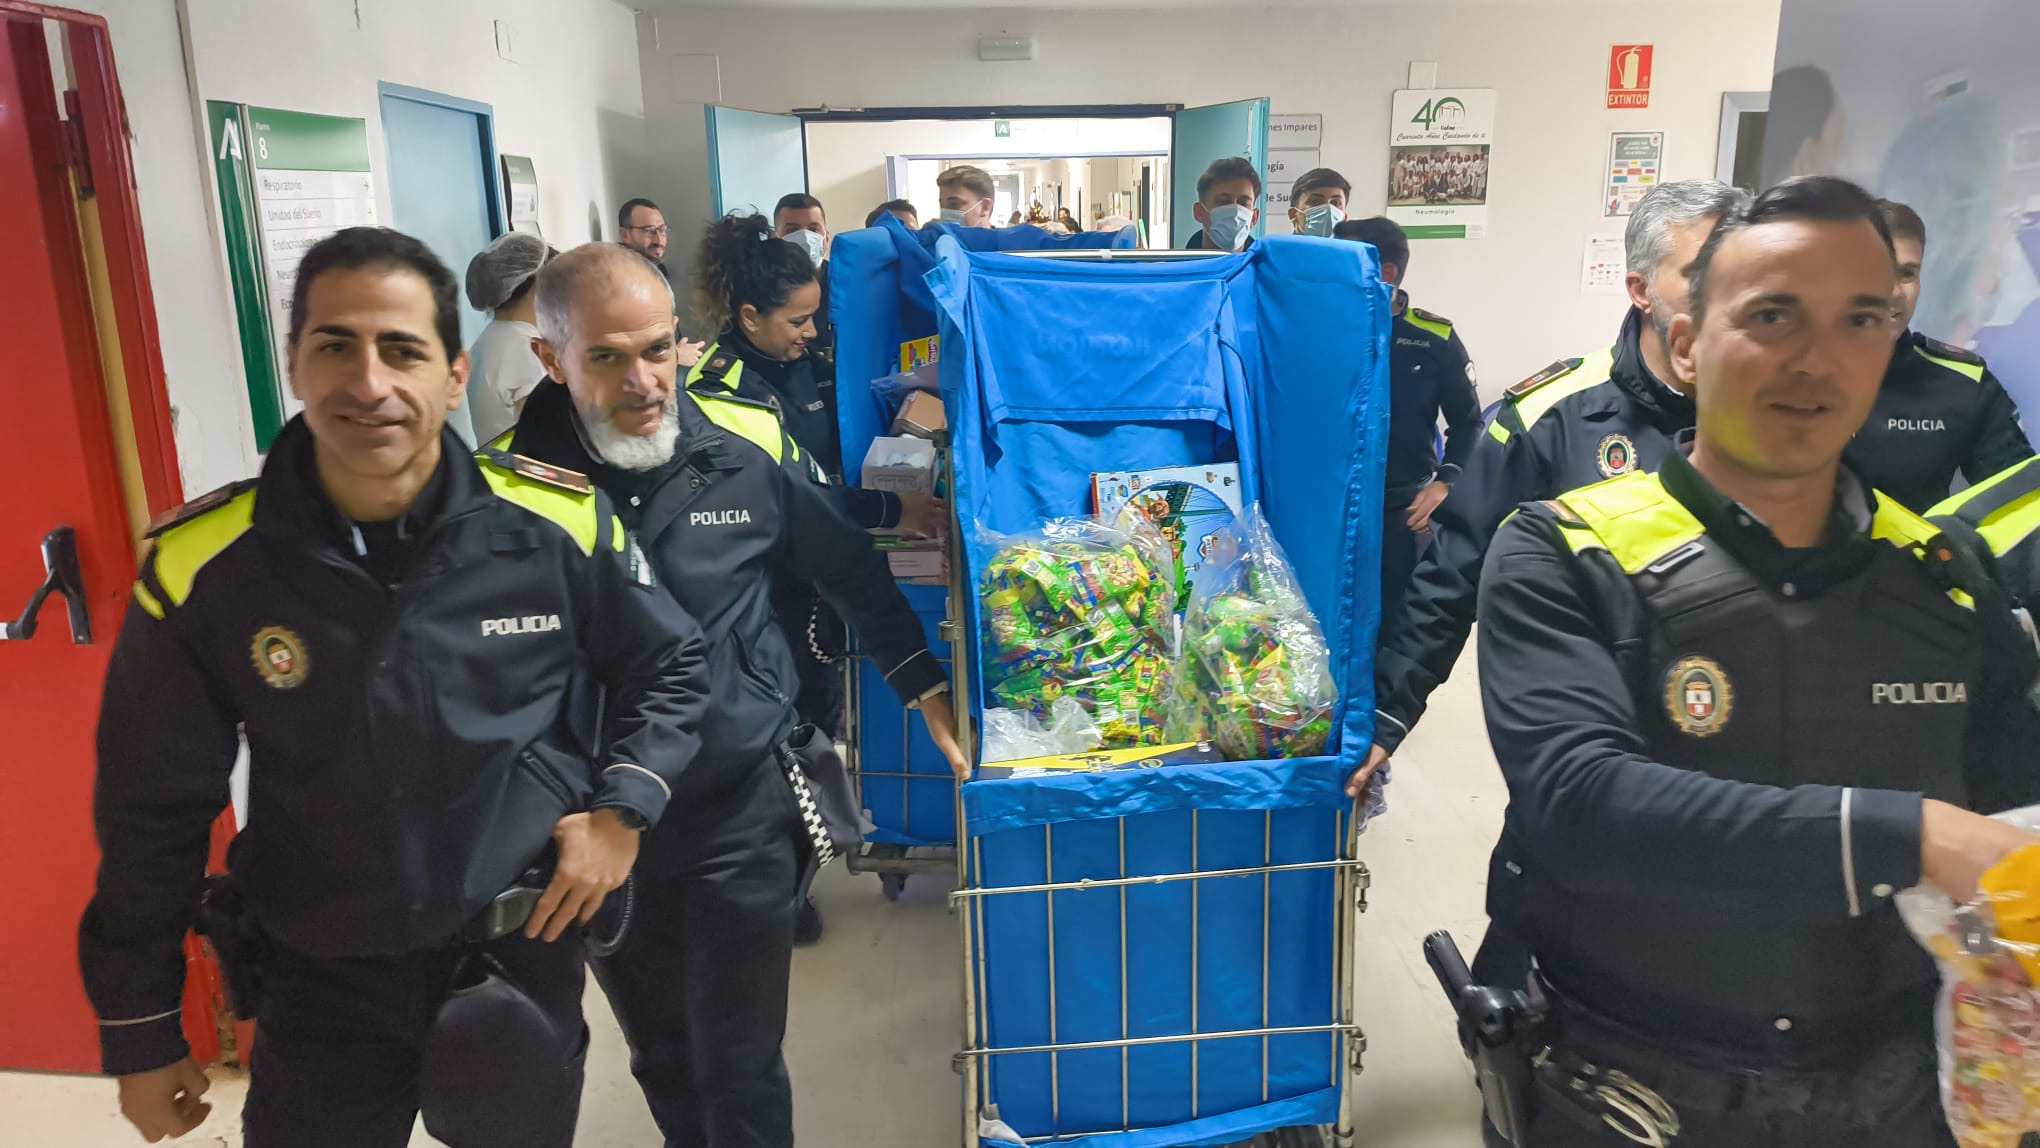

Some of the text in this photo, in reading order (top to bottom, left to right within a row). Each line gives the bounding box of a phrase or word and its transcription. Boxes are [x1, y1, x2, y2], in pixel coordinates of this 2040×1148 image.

[1609, 94, 1648, 105] EXTINTOR
[1284, 123, 1317, 133] Impares
[259, 137, 268, 159] 8
[263, 179, 302, 192] Respiratorio
[268, 208, 291, 221] Unidad
[1396, 337, 1431, 348] POLICIA
[1888, 418, 1945, 431] POLICIA
[690, 509, 751, 526] POLICIA
[481, 614, 562, 637] POLICIA
[1872, 682, 1967, 704] POLICIA
